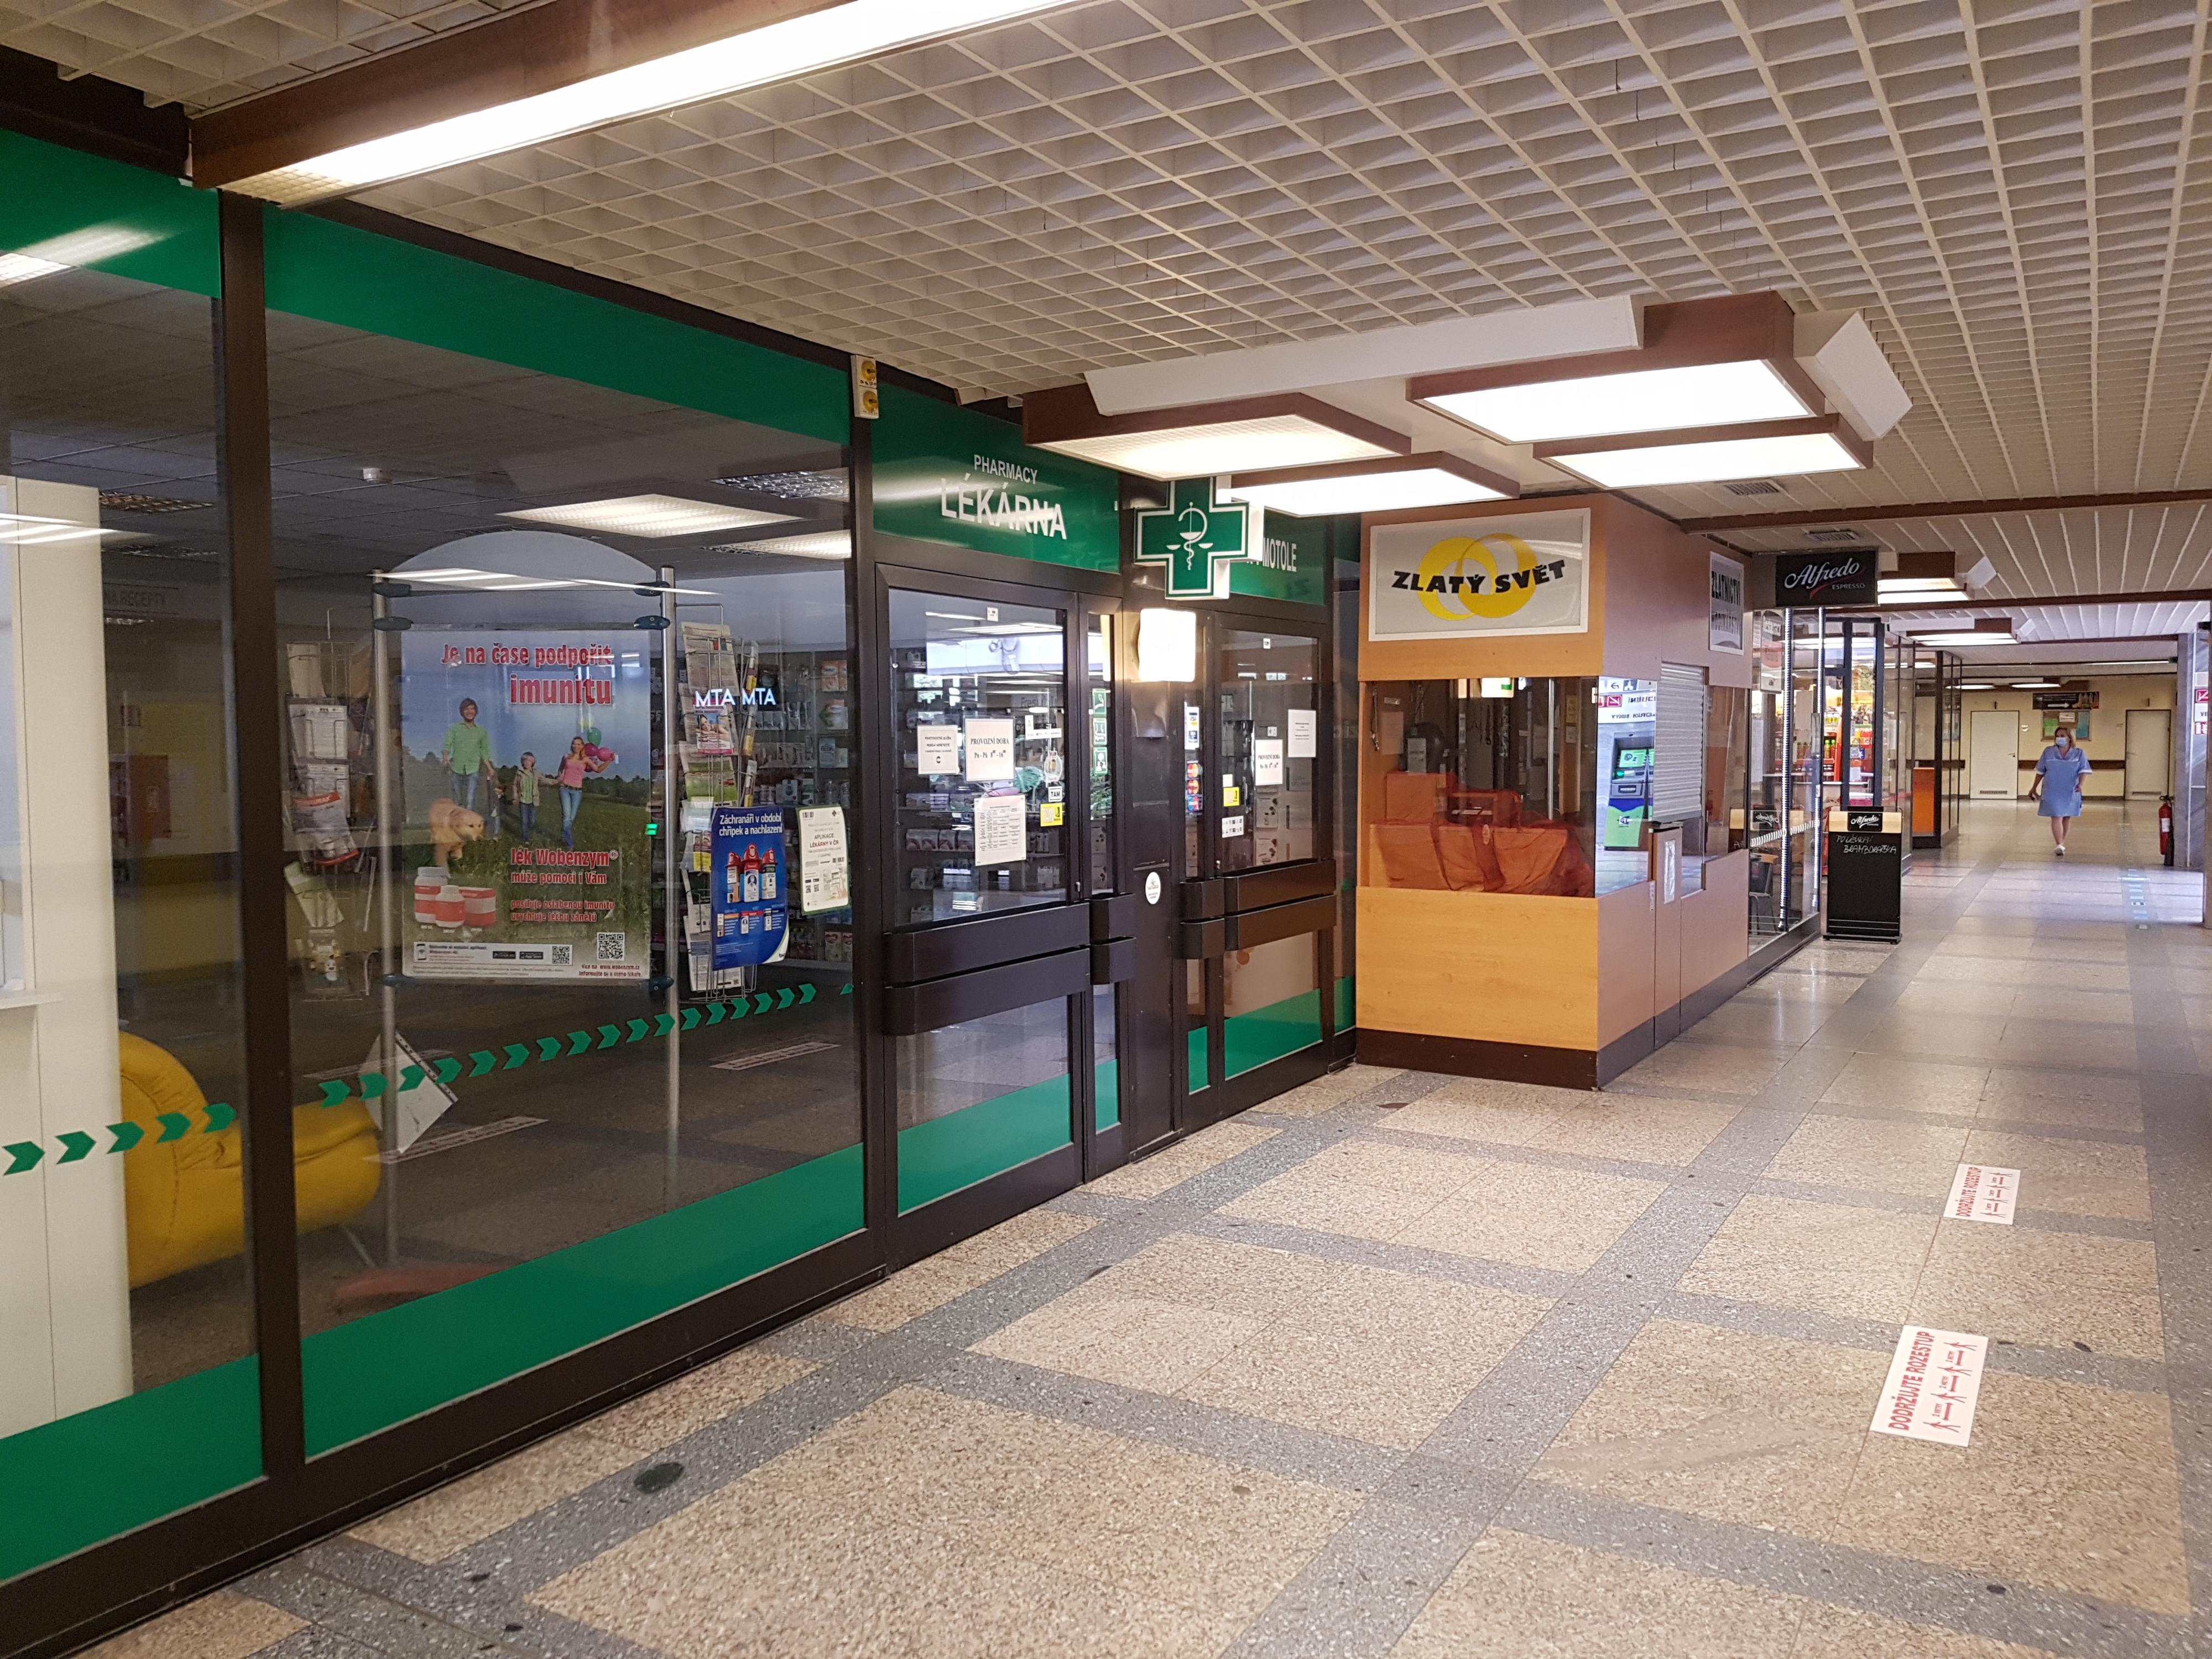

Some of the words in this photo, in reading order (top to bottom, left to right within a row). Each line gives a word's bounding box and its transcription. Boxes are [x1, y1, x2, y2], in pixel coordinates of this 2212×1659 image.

[974, 455, 1037, 484] PHARMACY
[941, 473, 1067, 540] LÉKÁRNA
[1262, 537, 1297, 572] MOTOLE
[1391, 571, 1486, 593] ZLATÝ
[1495, 560, 1565, 593] SVĚT
[1785, 558, 1860, 589] Alfredo
[441, 644, 458, 664] Je
[466, 646, 486, 664] na
[492, 642, 529, 665] čase
[535, 643, 613, 668] podpořit
[510, 674, 613, 705] imunitu
[971, 736, 995, 745] PROVOZNÍ
[719, 826, 743, 837] chřipek
[750, 823, 782, 834] nachlazení
[720, 813, 754, 824] Záchranáři
[760, 812, 781, 823] období
[511, 847, 532, 865] lék
[511, 870, 538, 883] může
[540, 871, 576, 885] pomoci
[578, 872, 583, 884] i
[585, 871, 607, 884] Vám
[585, 900, 615, 910] imunitu
[1905, 1331, 1935, 1374] ROZESTUP
[1888, 1375, 1923, 1431] DODRŽUJTE
